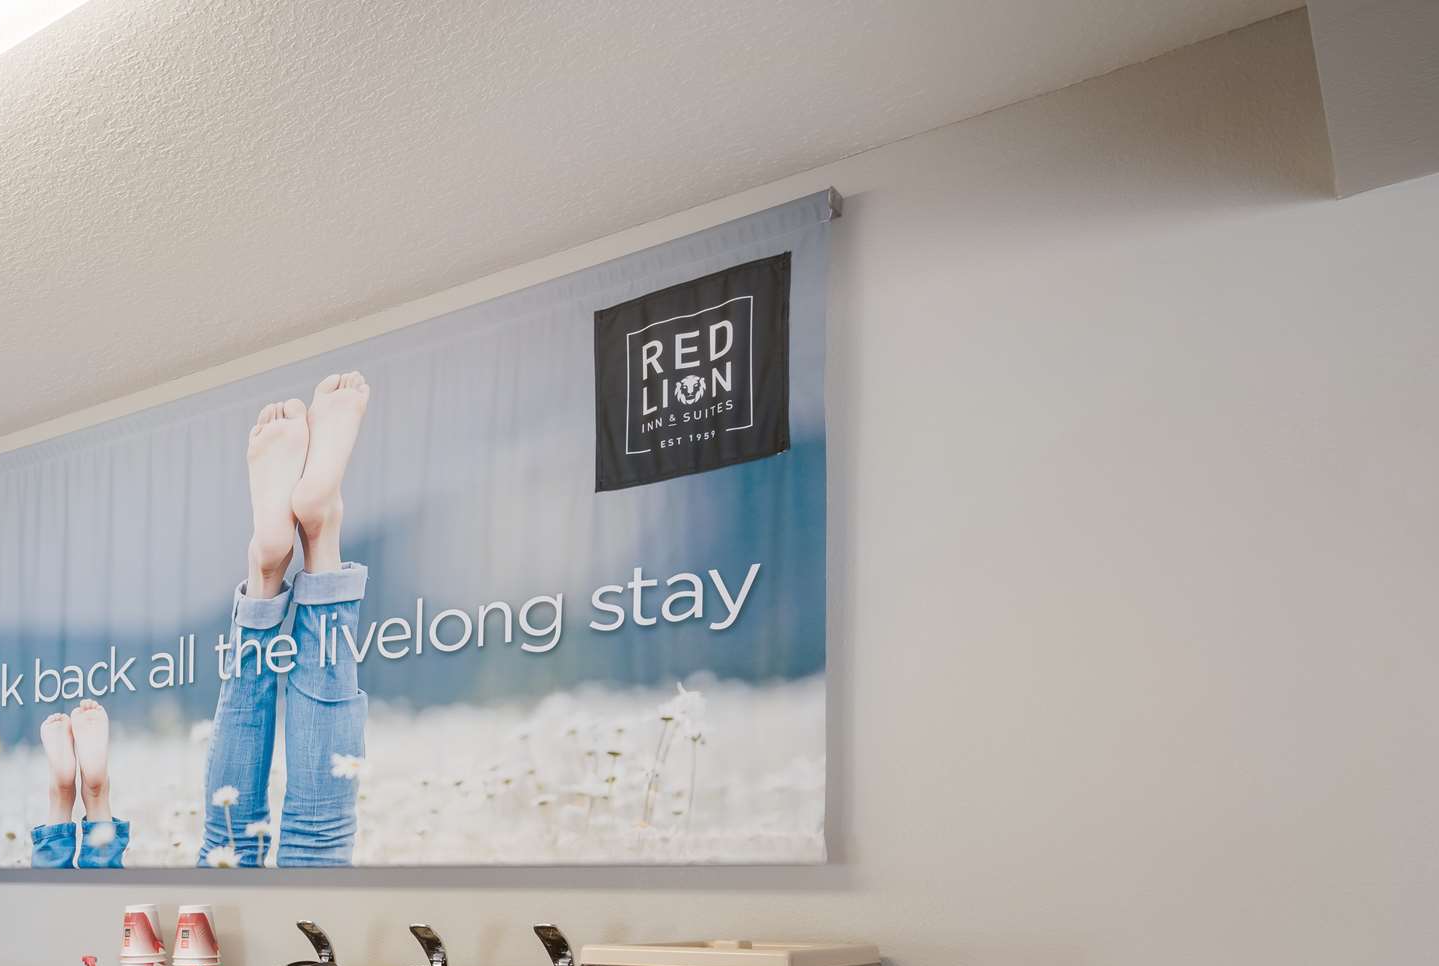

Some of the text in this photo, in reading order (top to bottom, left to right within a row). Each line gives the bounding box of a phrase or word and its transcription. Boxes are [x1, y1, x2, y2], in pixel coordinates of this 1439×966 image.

[642, 320, 734, 381] RED
[641, 399, 734, 434] INN & SUITES
[660, 430, 716, 449] EST 1959
[34, 653, 137, 703] back
[148, 633, 196, 690] all
[214, 628, 298, 681] the
[318, 592, 564, 669] livelong
[589, 563, 761, 632] stay
